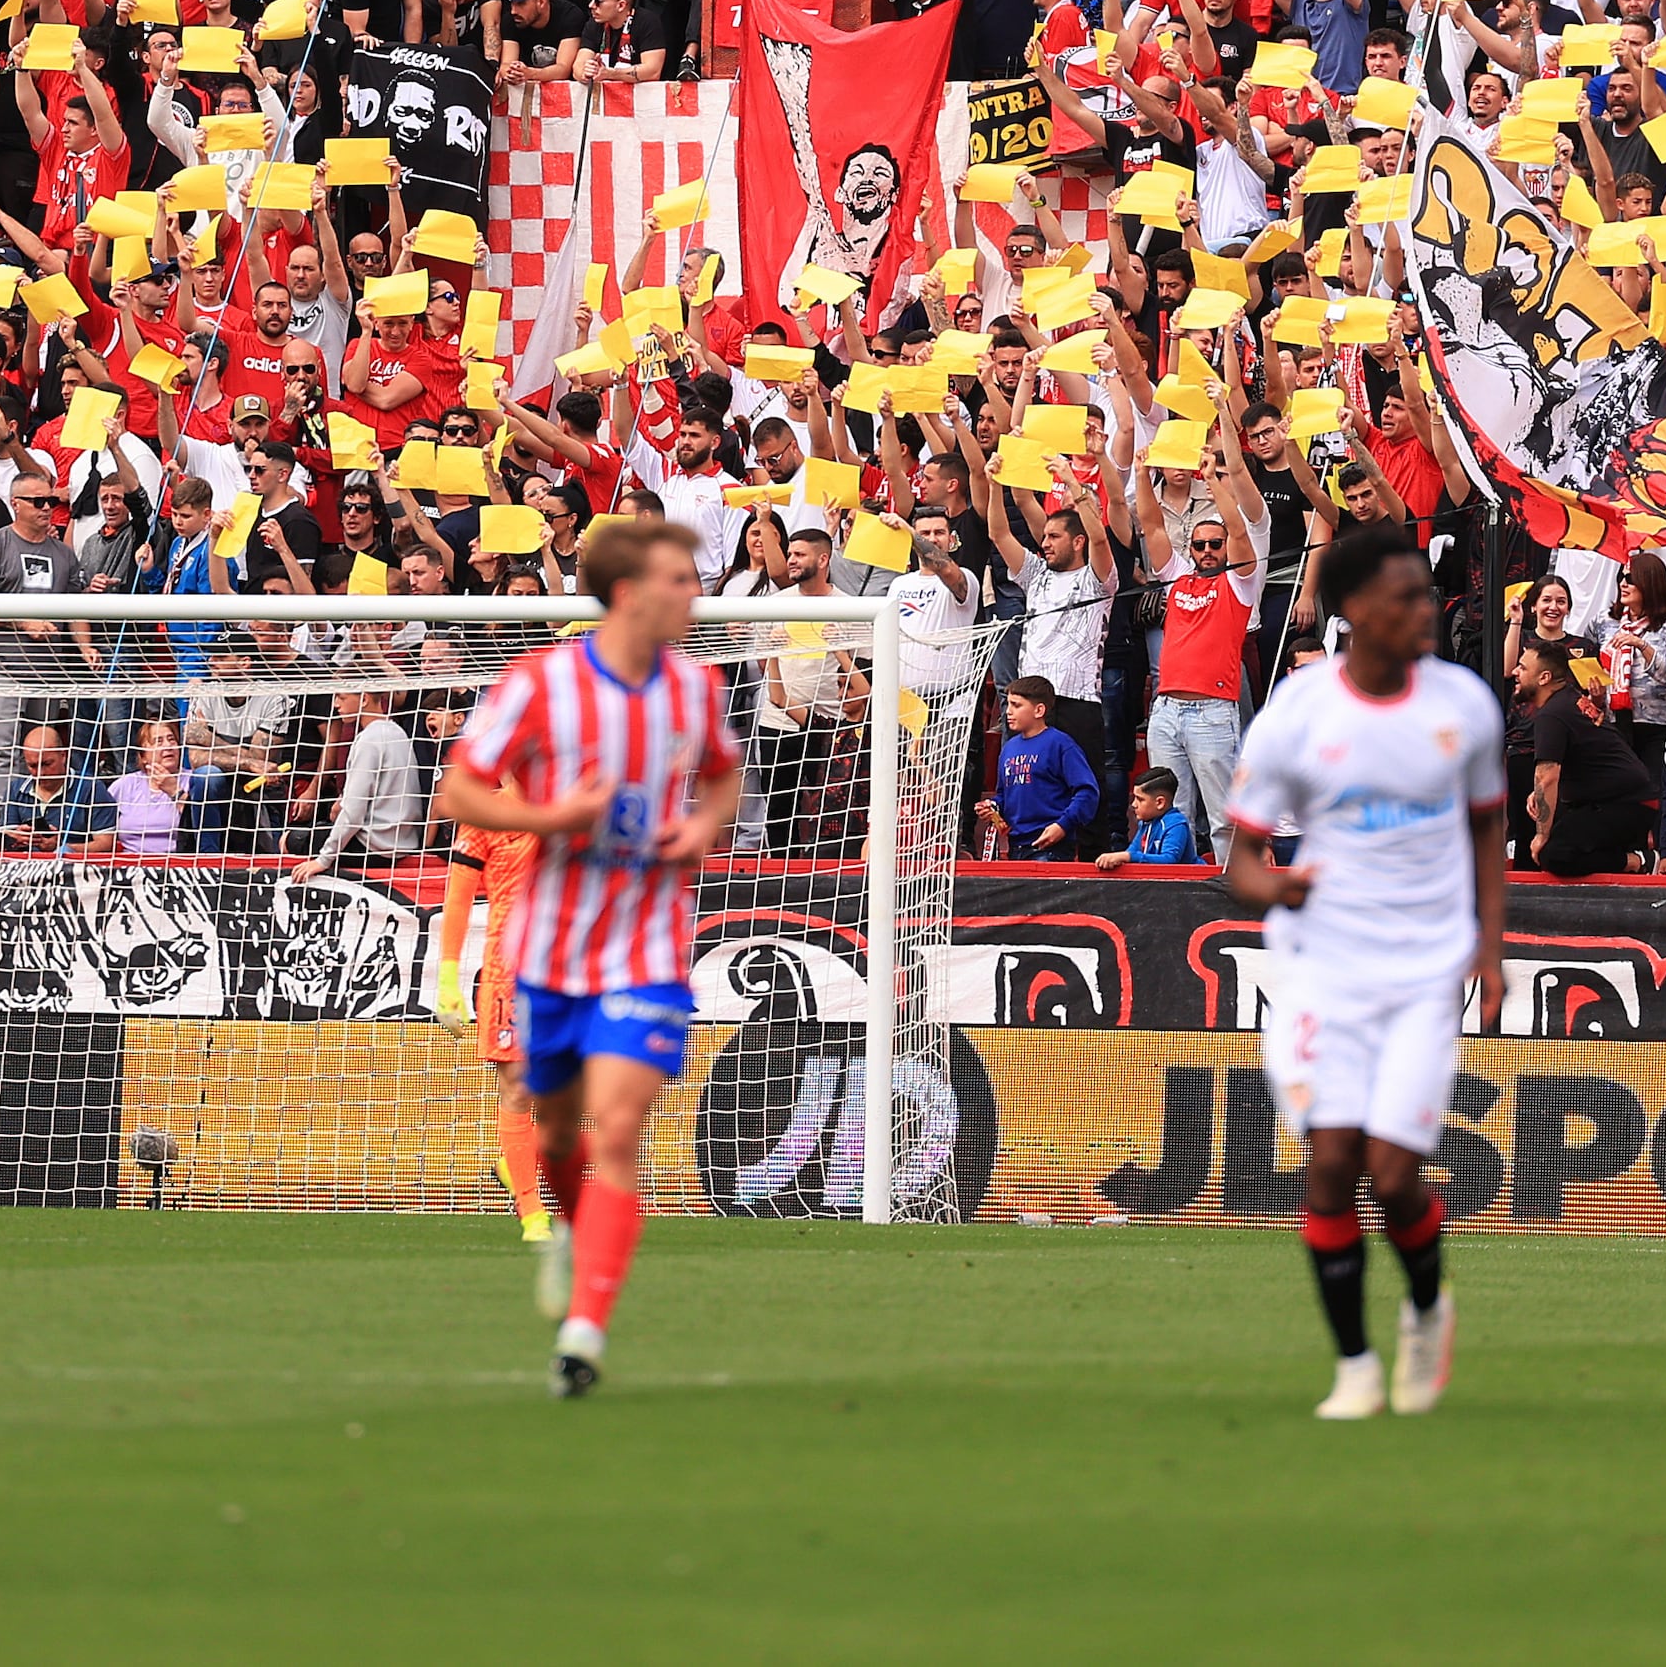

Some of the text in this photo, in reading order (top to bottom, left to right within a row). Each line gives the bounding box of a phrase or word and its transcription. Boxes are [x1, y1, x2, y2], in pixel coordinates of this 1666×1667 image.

[968, 84, 1046, 126] ONTRA
[968, 115, 1053, 165] 9/20
[243, 355, 281, 374] adid
